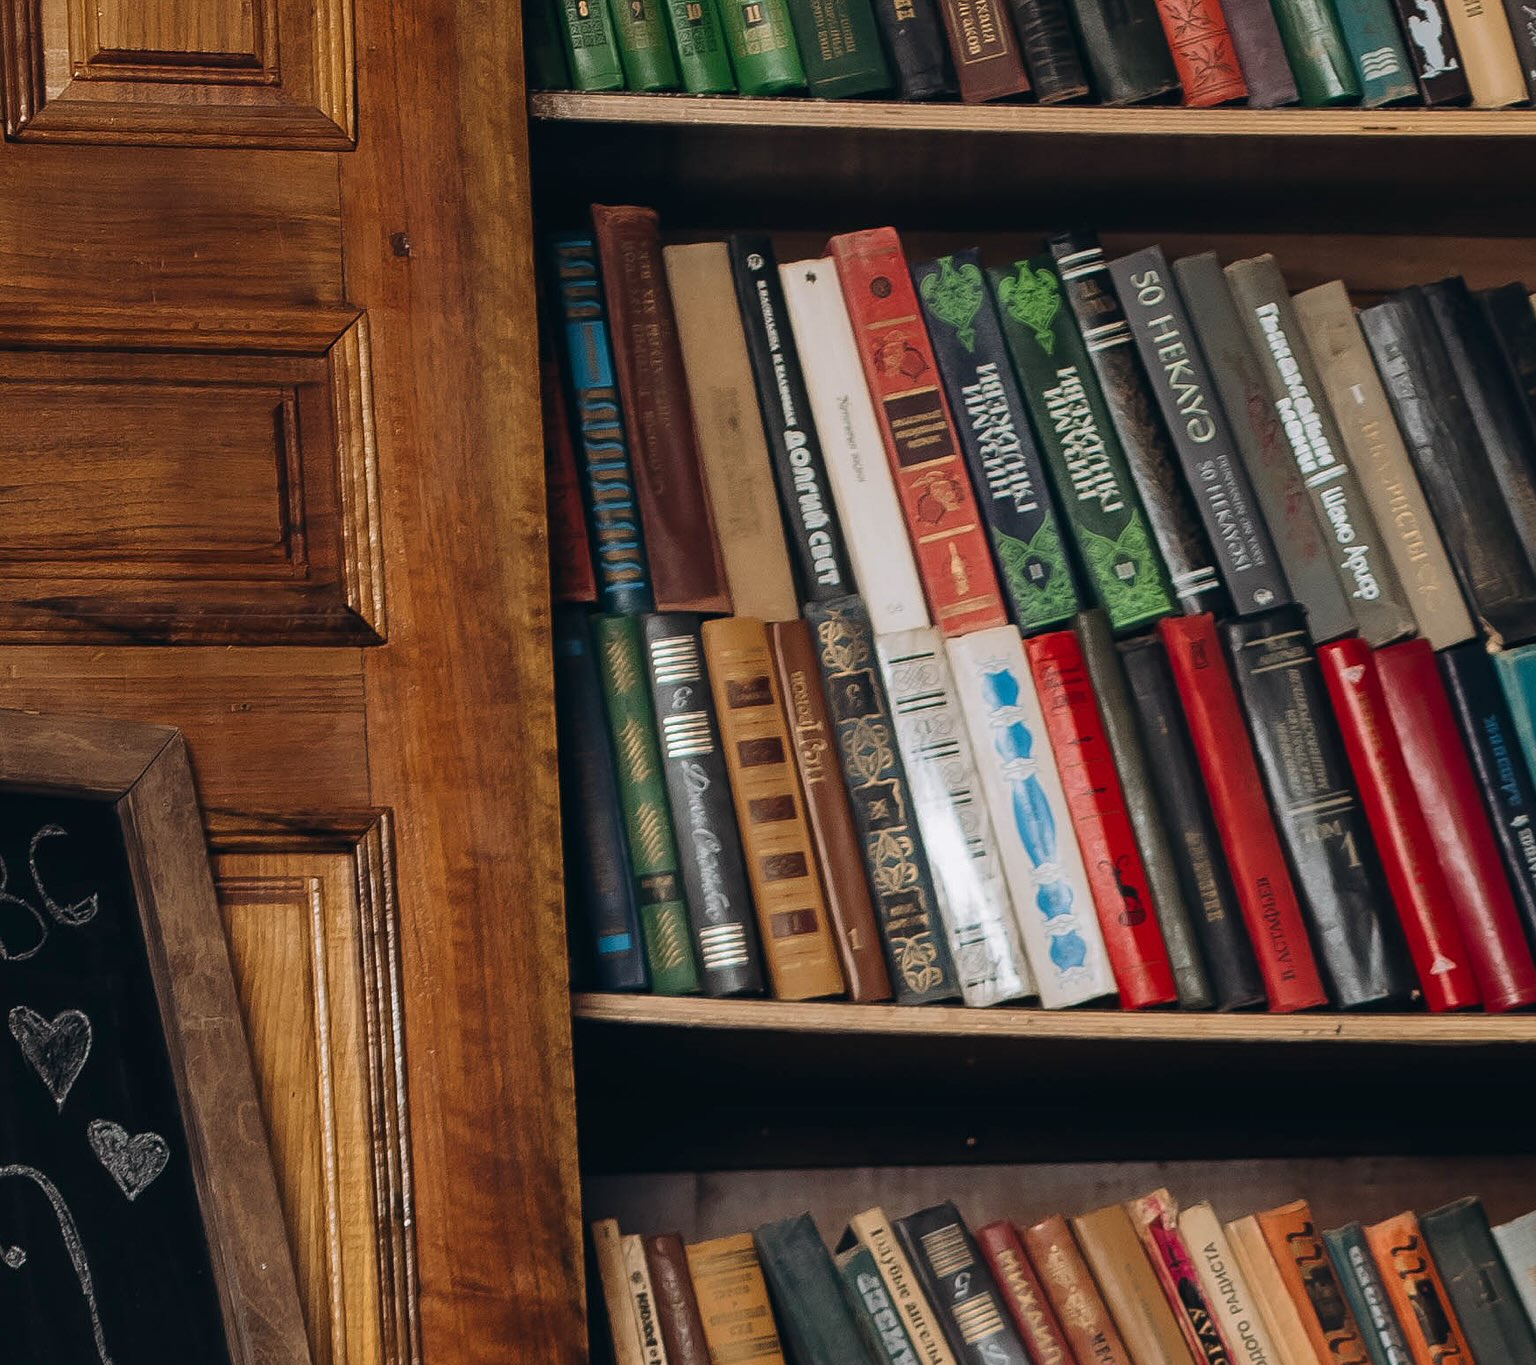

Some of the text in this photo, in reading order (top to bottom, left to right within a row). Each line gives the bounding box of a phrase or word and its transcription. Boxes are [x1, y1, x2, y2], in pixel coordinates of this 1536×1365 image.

[1141, 311, 1223, 446] HEKAYƏ
[951, 380, 1021, 501] НИЗАМИ
[1037, 385, 1102, 503] НИЗАМИ
[782, 426, 829, 530] ДОЛГИЙ
[806, 528, 840, 588] СВЕТ
[1317, 484, 1389, 606] Шамо Ариф
[1253, 874, 1291, 964] АСТАФЬЕВ
[865, 1226, 947, 1365] Голубые ангелы
[1198, 1241, 1246, 1315] РАДИСТА
